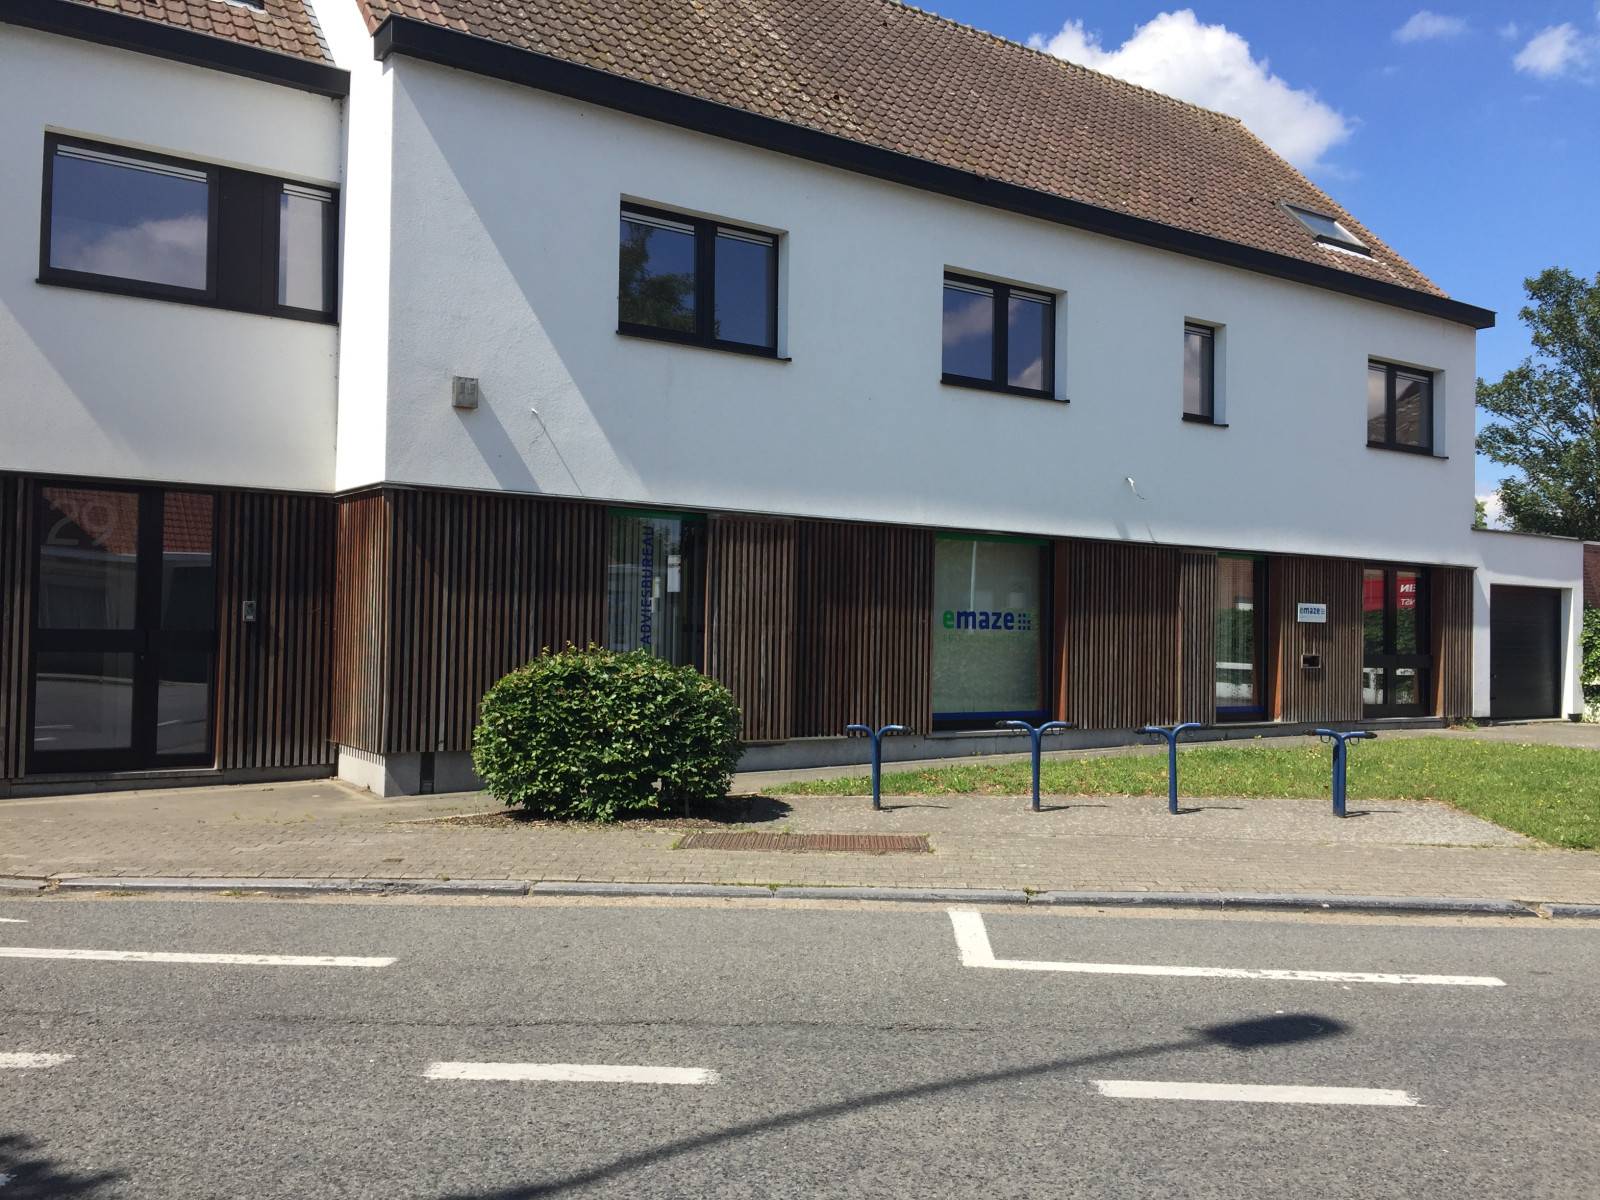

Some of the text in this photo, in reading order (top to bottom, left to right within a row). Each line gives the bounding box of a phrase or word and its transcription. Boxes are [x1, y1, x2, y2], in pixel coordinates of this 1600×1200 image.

[47, 499, 119, 546] 29
[639, 526, 654, 645] ADVIESBUREAU
[943, 610, 1014, 631] emaze
